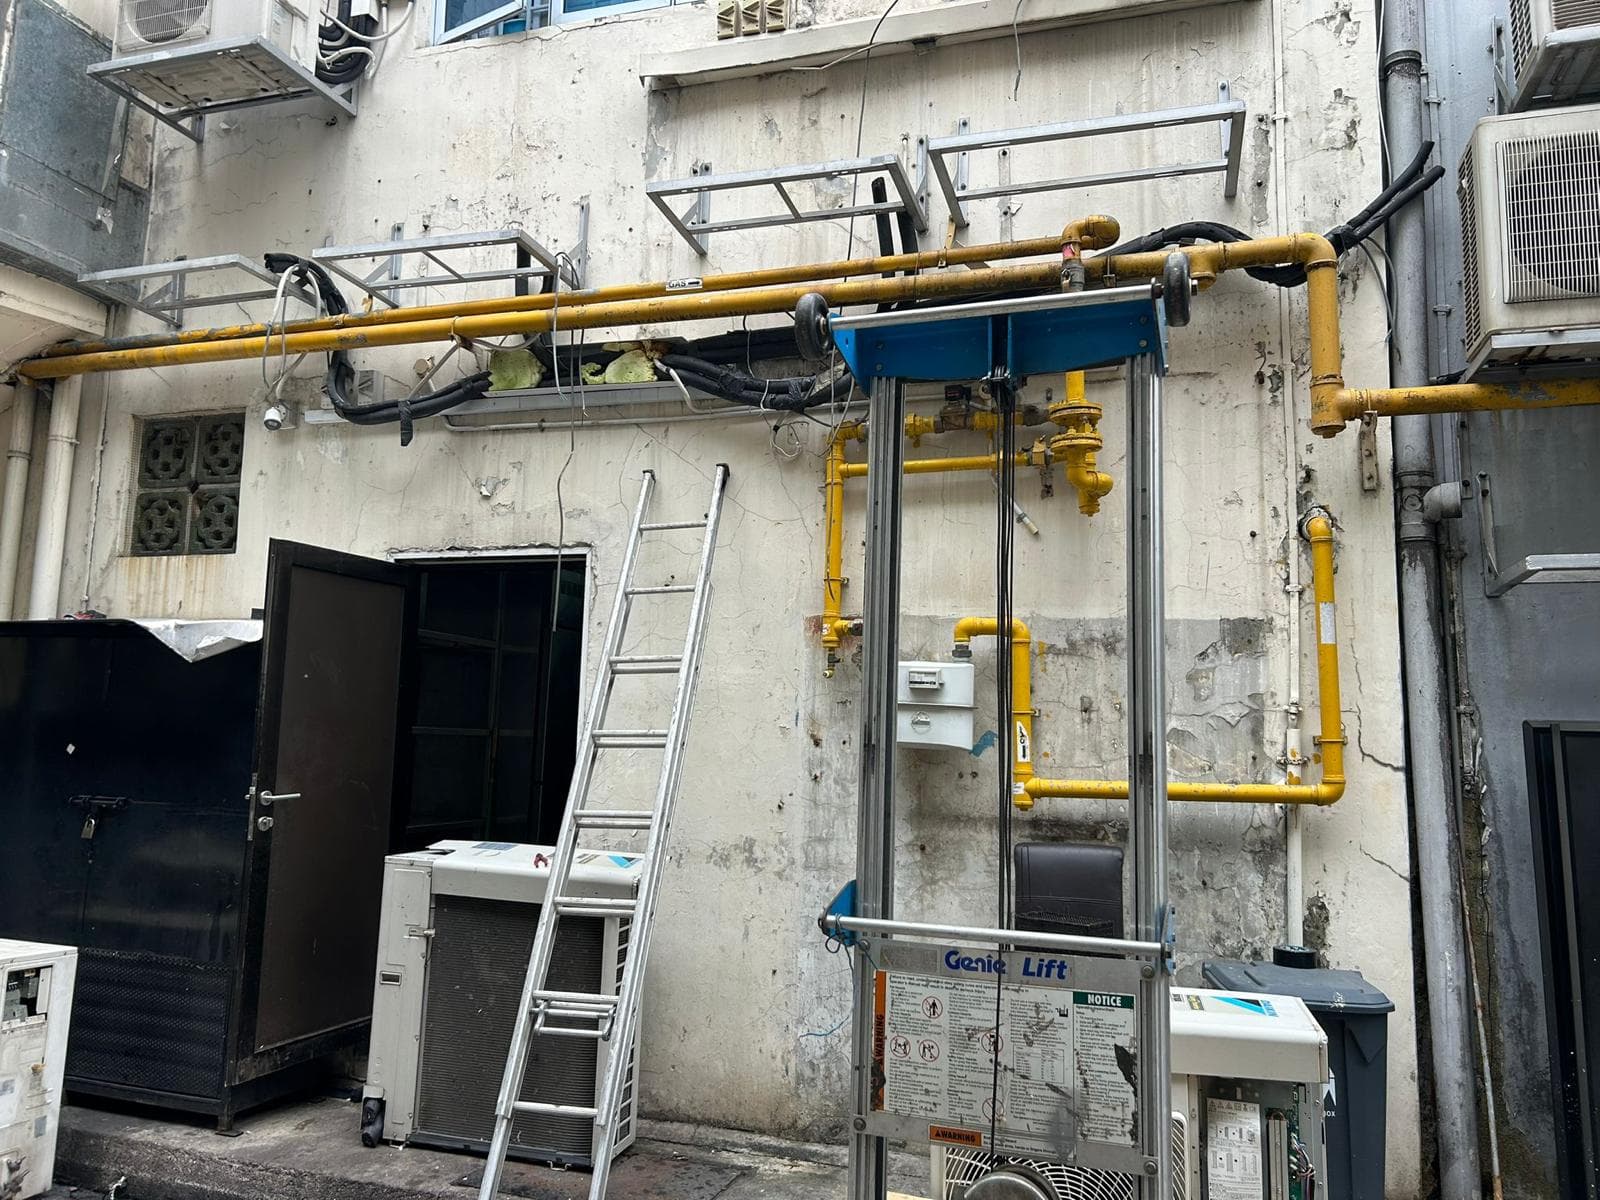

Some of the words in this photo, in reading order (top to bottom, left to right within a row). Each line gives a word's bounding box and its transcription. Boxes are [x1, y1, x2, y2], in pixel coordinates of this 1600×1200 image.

[669, 279, 687, 289] GAS
[944, 949, 1007, 975] Genie
[1022, 956, 1068, 980] Lift
[1087, 993, 1122, 1007] NOTICE
[875, 1014, 885, 1057] WARNING
[942, 1129, 976, 1143] WARNING
